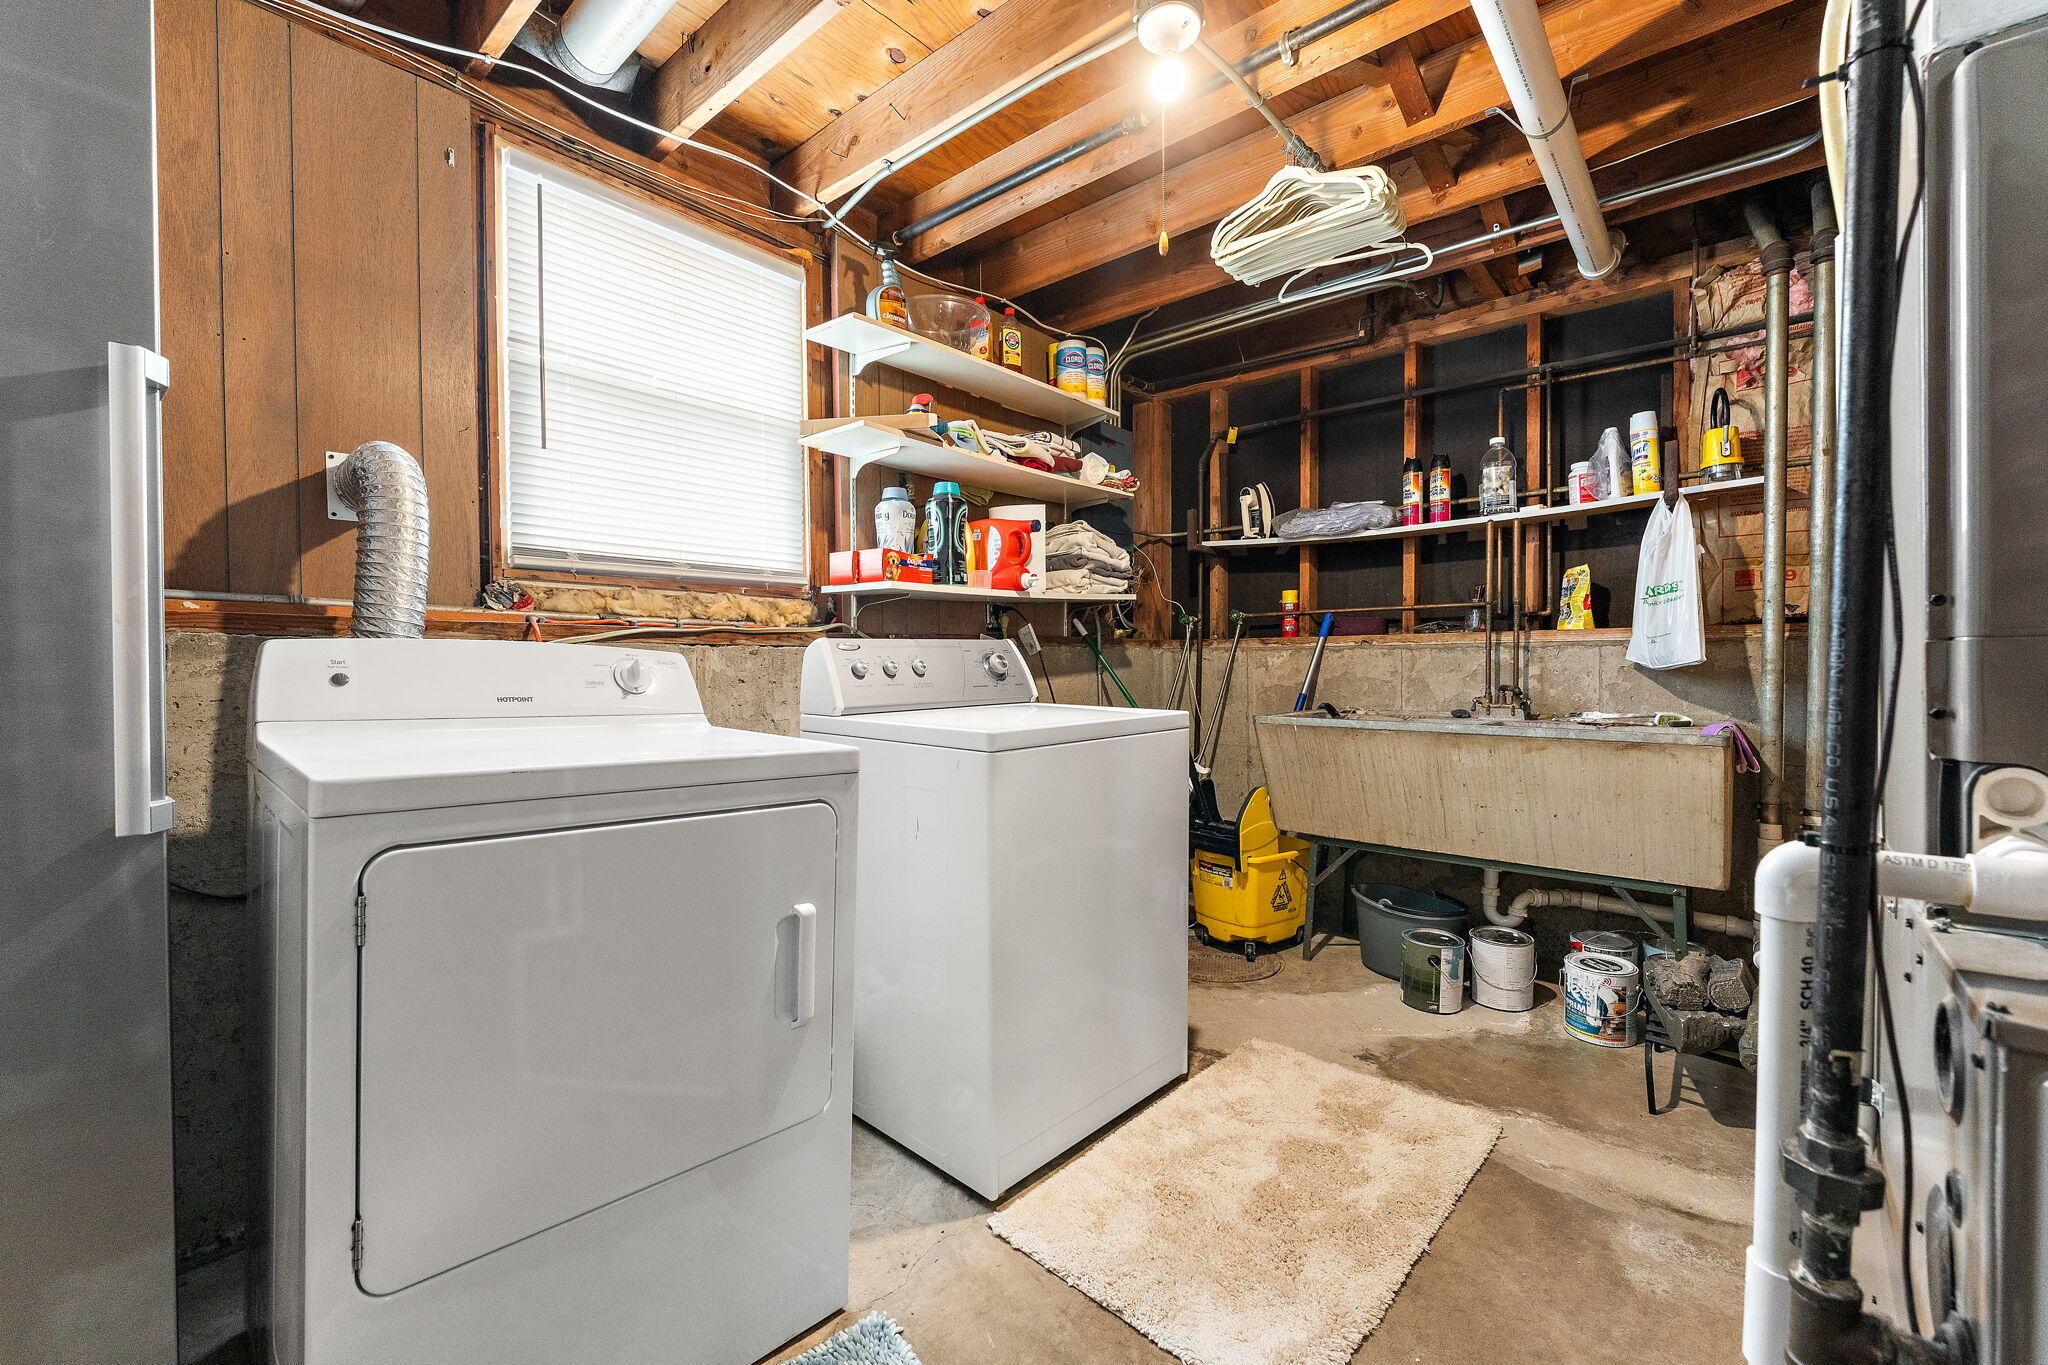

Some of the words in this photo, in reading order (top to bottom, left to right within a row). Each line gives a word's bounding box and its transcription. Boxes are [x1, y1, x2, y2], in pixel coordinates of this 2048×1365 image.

[882, 312, 906, 323] cleaner
[1065, 355, 1084, 363] CLOROX
[1087, 363, 1104, 371] CLOROX
[1882, 854, 1924, 869] ASTM
[1928, 861, 1938, 870] D
[1801, 956, 1814, 975] 40
[1800, 980, 1813, 1010] SCH
